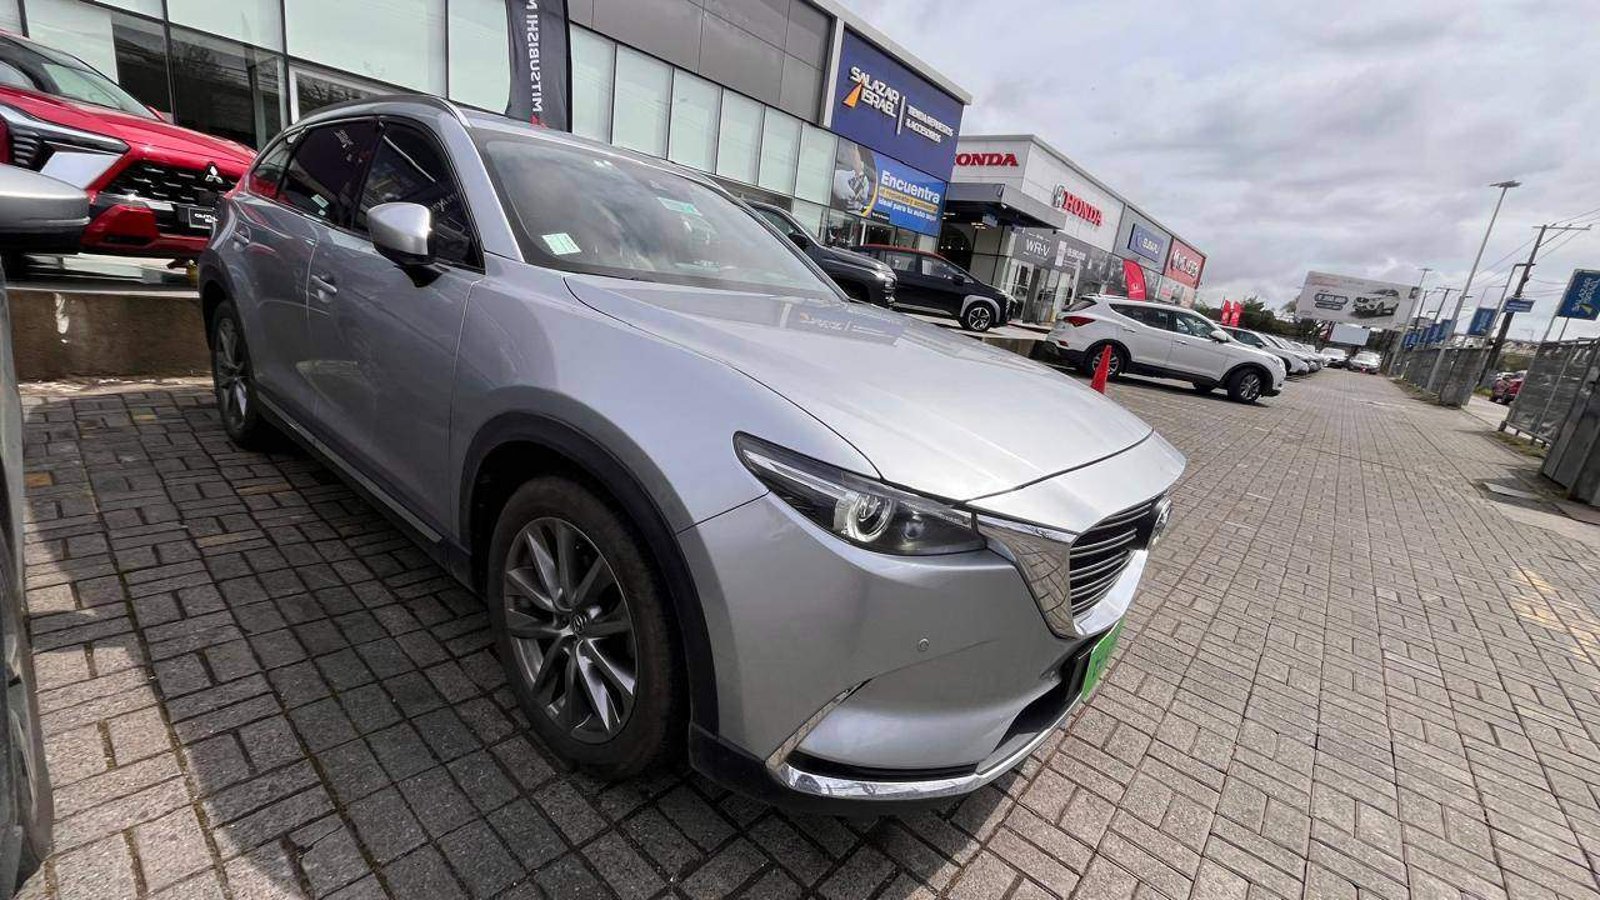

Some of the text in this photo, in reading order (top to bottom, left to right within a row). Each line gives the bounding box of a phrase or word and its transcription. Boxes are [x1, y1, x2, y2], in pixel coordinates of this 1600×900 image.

[849, 66, 900, 105] SALAZAR
[861, 88, 897, 118] ISRAEL
[954, 153, 1019, 167] ONDA
[880, 169, 940, 204] Encuentra
[1062, 189, 1103, 227] HONDA
[1026, 239, 1050, 256] WR-V
